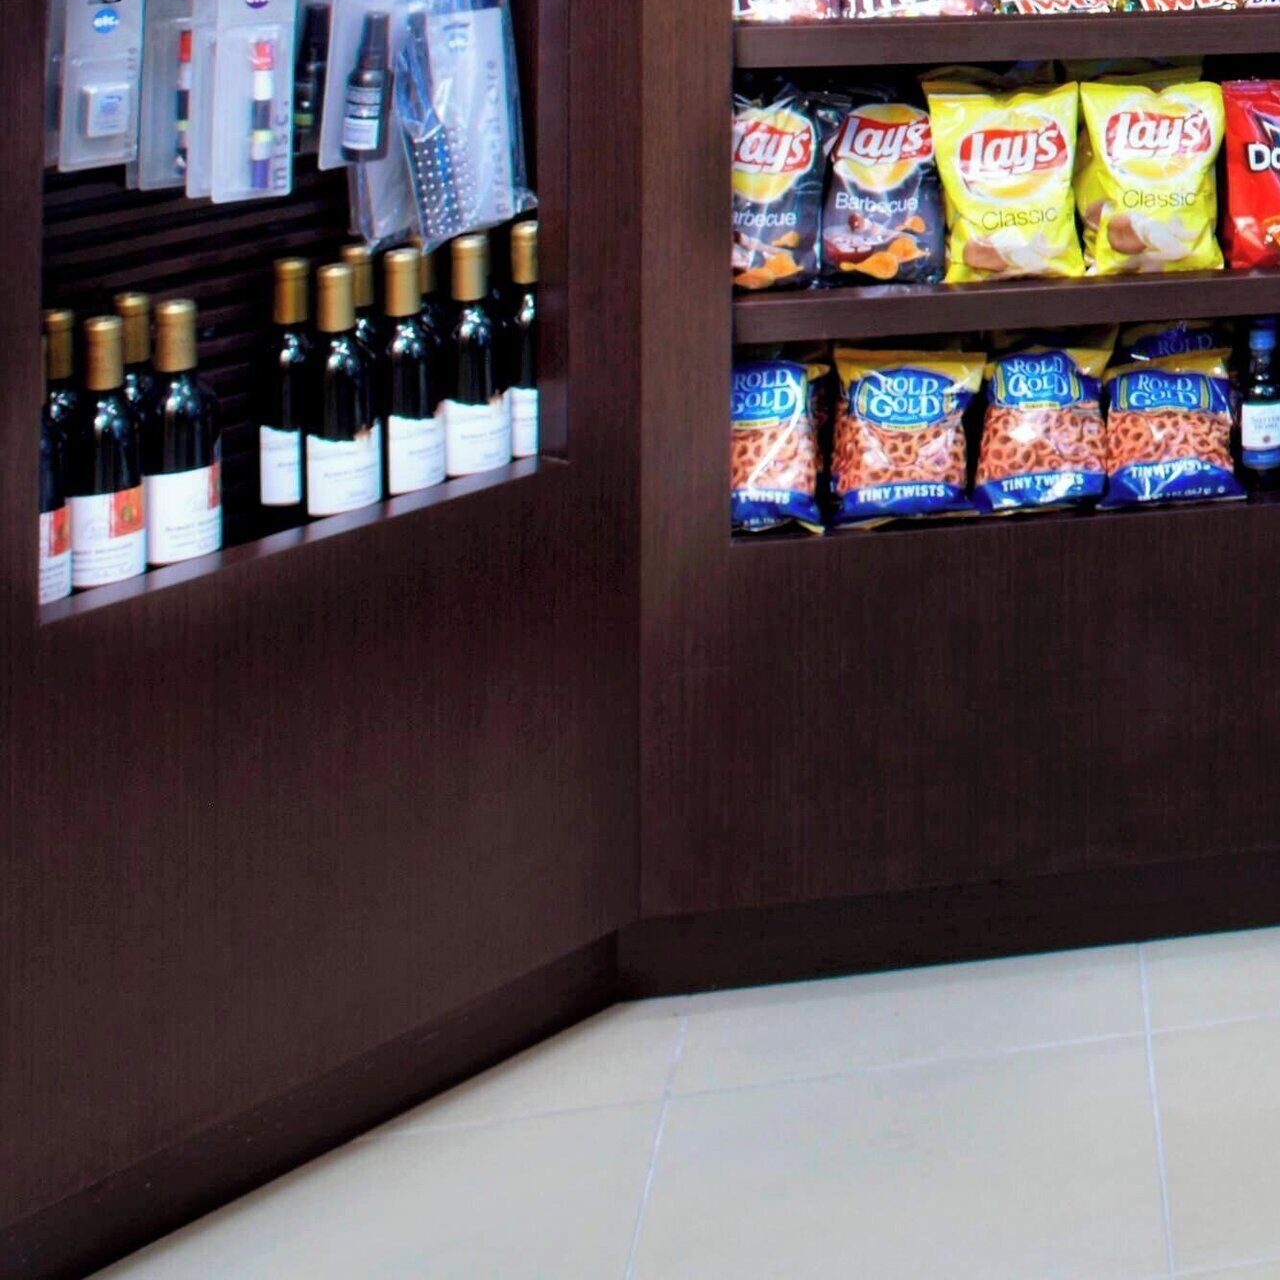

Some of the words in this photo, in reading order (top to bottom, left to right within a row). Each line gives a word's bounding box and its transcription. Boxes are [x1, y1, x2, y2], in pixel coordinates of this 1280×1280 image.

[838, 117, 931, 166] Lay's
[1116, 110, 1204, 158] Lay's
[967, 125, 1059, 177] Lay's
[835, 191, 919, 214] Barbecue
[1122, 188, 1198, 209] Classic
[981, 207, 1058, 231] Classic
[1009, 356, 1063, 375] ROLD
[881, 376, 939, 394] ROLD
[1007, 373, 1069, 399] GOLD
[1137, 375, 1194, 391] ROLD
[869, 395, 940, 418] GOLD
[1129, 388, 1197, 408] GOLD
[858, 487, 890, 503] TINY
[893, 484, 946, 500] TWISTS
[1002, 477, 1031, 493] TINY
